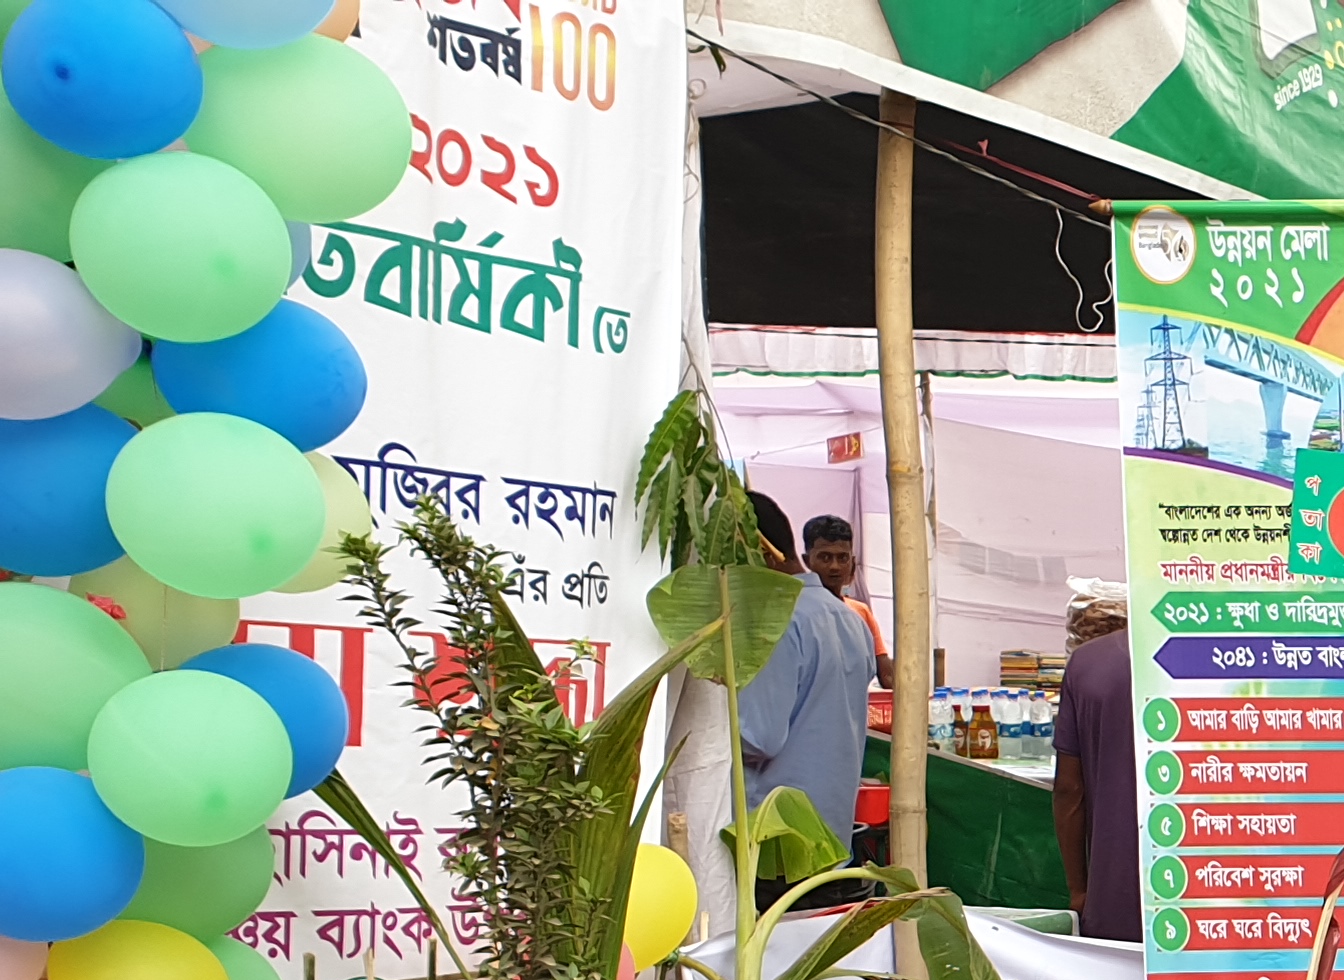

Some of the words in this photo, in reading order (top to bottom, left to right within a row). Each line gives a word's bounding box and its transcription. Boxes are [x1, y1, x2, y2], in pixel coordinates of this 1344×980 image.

[529, 3, 616, 110] 100
[1273, 77, 1301, 110] since
[1299, 63, 1323, 94] 1929
[1205, 216, 1273, 267] উন্নয়ন
[1280, 222, 1330, 262] মেলা
[1210, 267, 1305, 309] ২০২১
[500, 476, 617, 541] রহমান
[1224, 506, 1241, 519] এক
[1245, 506, 1272, 520] অনন্য
[1201, 528, 1220, 543] দেশ
[1224, 528, 1250, 543] থেকে
[562, 561, 610, 609] প্রতি
[1160, 556, 1216, 583] মাননীয়
[1164, 602, 1210, 628] ২০২১
[1225, 601, 1260, 628] ক্ষুধা
[1265, 605, 1279, 620] ও
[1212, 646, 1256, 669] ২০৪১
[1272, 640, 1313, 670] উন্নত
[1187, 708, 1228, 730] আমার
[1230, 703, 1260, 734] বাড়ি
[1263, 709, 1303, 730] আমার
[1306, 709, 1343, 730] খামার
[1158, 765, 1170, 782] ৩
[1189, 754, 1234, 784] নারীর
[1238, 762, 1308, 784] ক্ষমতায়ন
[1160, 816, 1172, 836] ৫
[1191, 808, 1234, 836] শিক্ষা
[1236, 814, 1297, 836] সহায়তা
[1163, 870, 1174, 888] ৭
[1195, 860, 1255, 888] পরিবেশ
[1258, 865, 1305, 892] সুরক্ষা
[1165, 920, 1176, 940] ৯
[1196, 919, 1228, 939] ঘরে
[1232, 918, 1264, 939] ঘরে
[1266, 912, 1313, 944] বিদ্যুৎ
